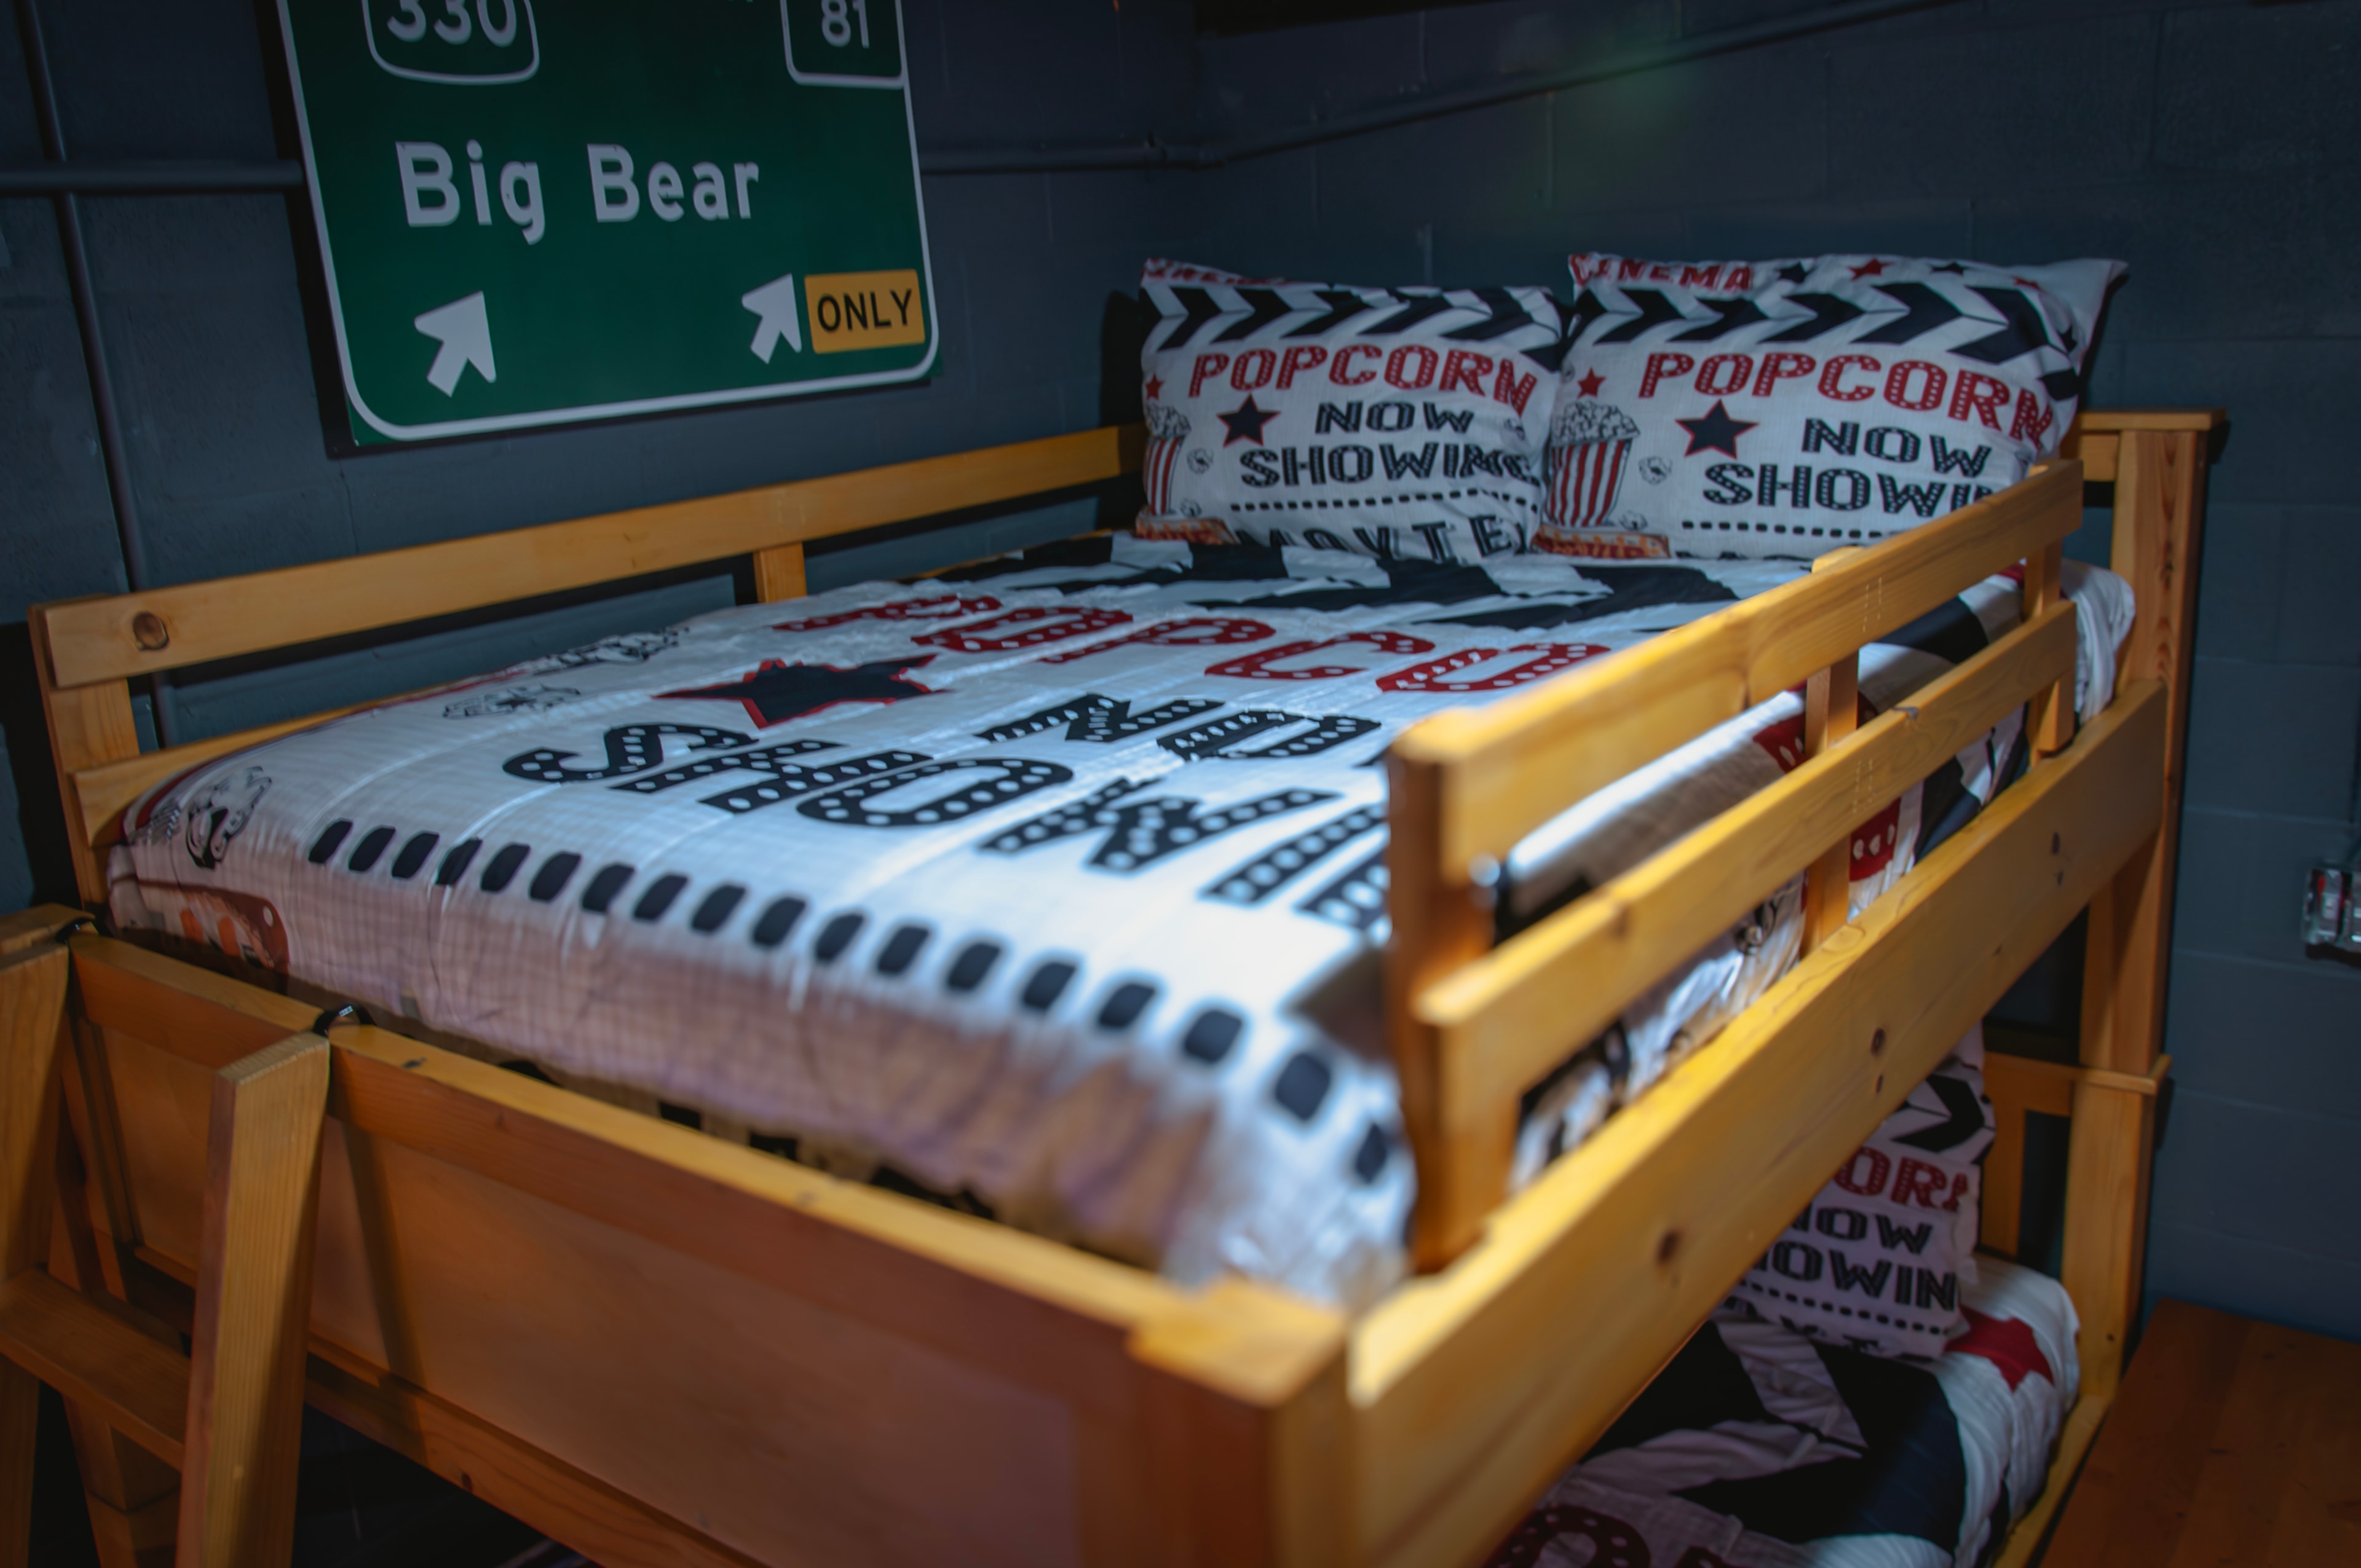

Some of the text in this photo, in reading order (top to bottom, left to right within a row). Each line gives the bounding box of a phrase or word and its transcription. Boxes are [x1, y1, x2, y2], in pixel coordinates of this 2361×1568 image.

[821, 0, 869, 49] 81
[395, 139, 760, 245] Big Bear
[817, 288, 912, 332] ONLY
[1188, 344, 1538, 418] POPCORN
[1638, 352, 2054, 453] POPCORN
[1315, 401, 1475, 435] NOW
[1802, 418, 1993, 479] NOW
